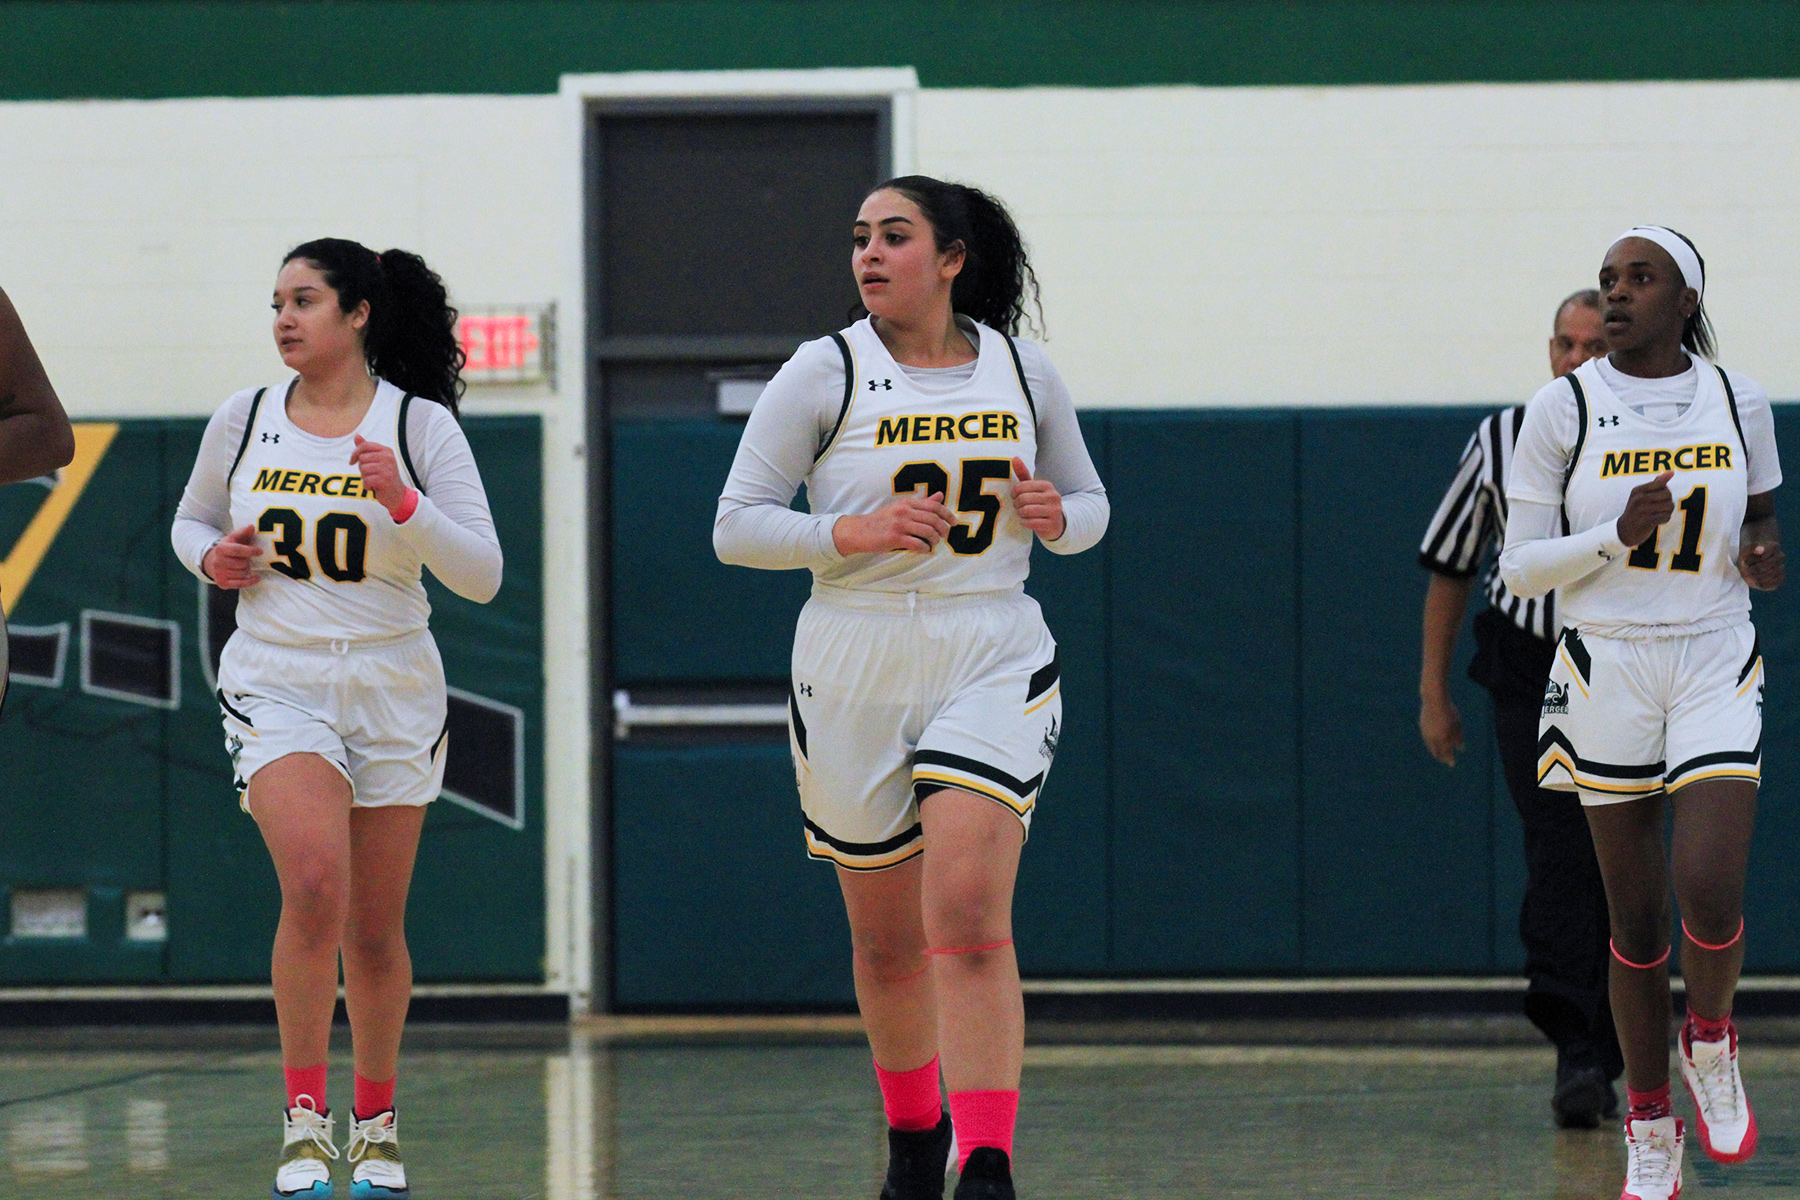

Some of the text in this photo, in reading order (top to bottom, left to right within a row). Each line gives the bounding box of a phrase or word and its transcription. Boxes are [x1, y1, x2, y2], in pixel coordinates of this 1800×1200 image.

[875, 411, 1020, 447] MERCER
[1600, 443, 1733, 479] MERCER
[257, 506, 369, 583] 30
